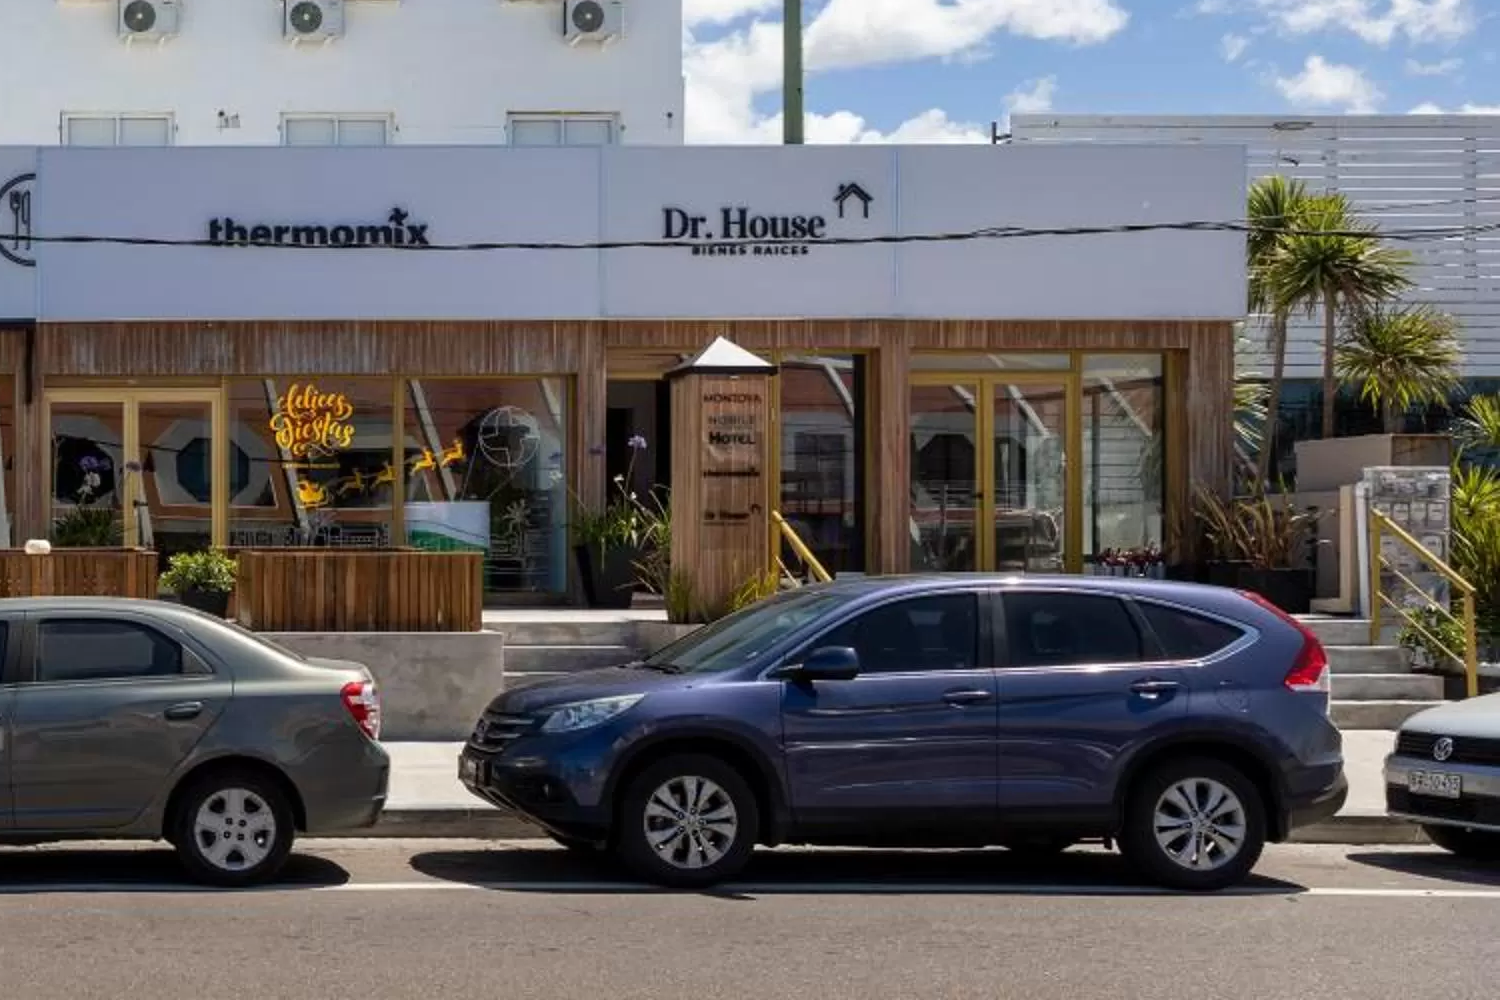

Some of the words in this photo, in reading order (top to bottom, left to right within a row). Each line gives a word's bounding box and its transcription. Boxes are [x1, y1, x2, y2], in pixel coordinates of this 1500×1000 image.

[209, 206, 429, 246] thermomix
[662, 207, 713, 239] Dr.
[720, 207, 827, 239] House
[691, 244, 747, 256] BIENES
